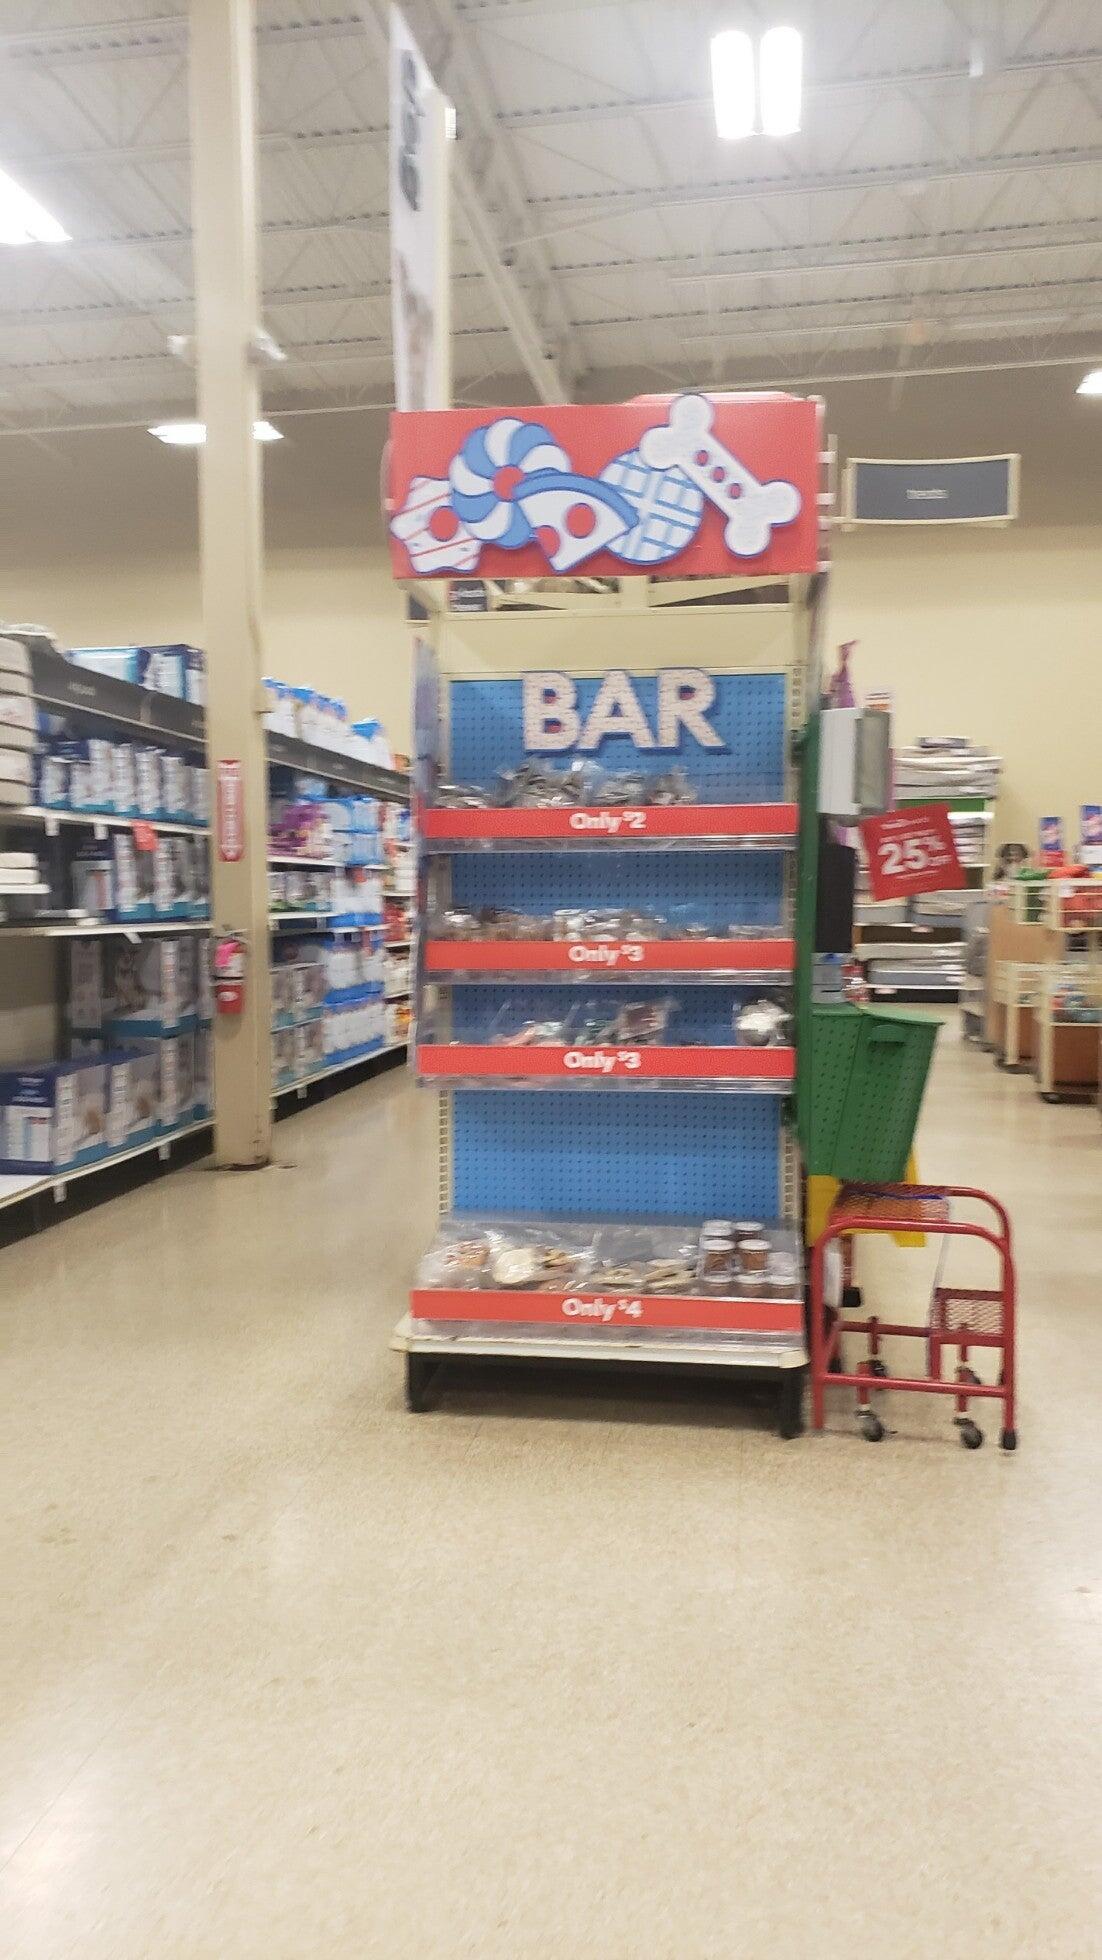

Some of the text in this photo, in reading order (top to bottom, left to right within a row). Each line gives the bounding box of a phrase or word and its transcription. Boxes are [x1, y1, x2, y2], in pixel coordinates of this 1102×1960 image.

[522, 668, 728, 753] BAR
[569, 811, 623, 833] Only
[568, 945, 645, 966] Only $3
[563, 1051, 642, 1073] Only $3
[561, 1298, 645, 1322] Only $4
